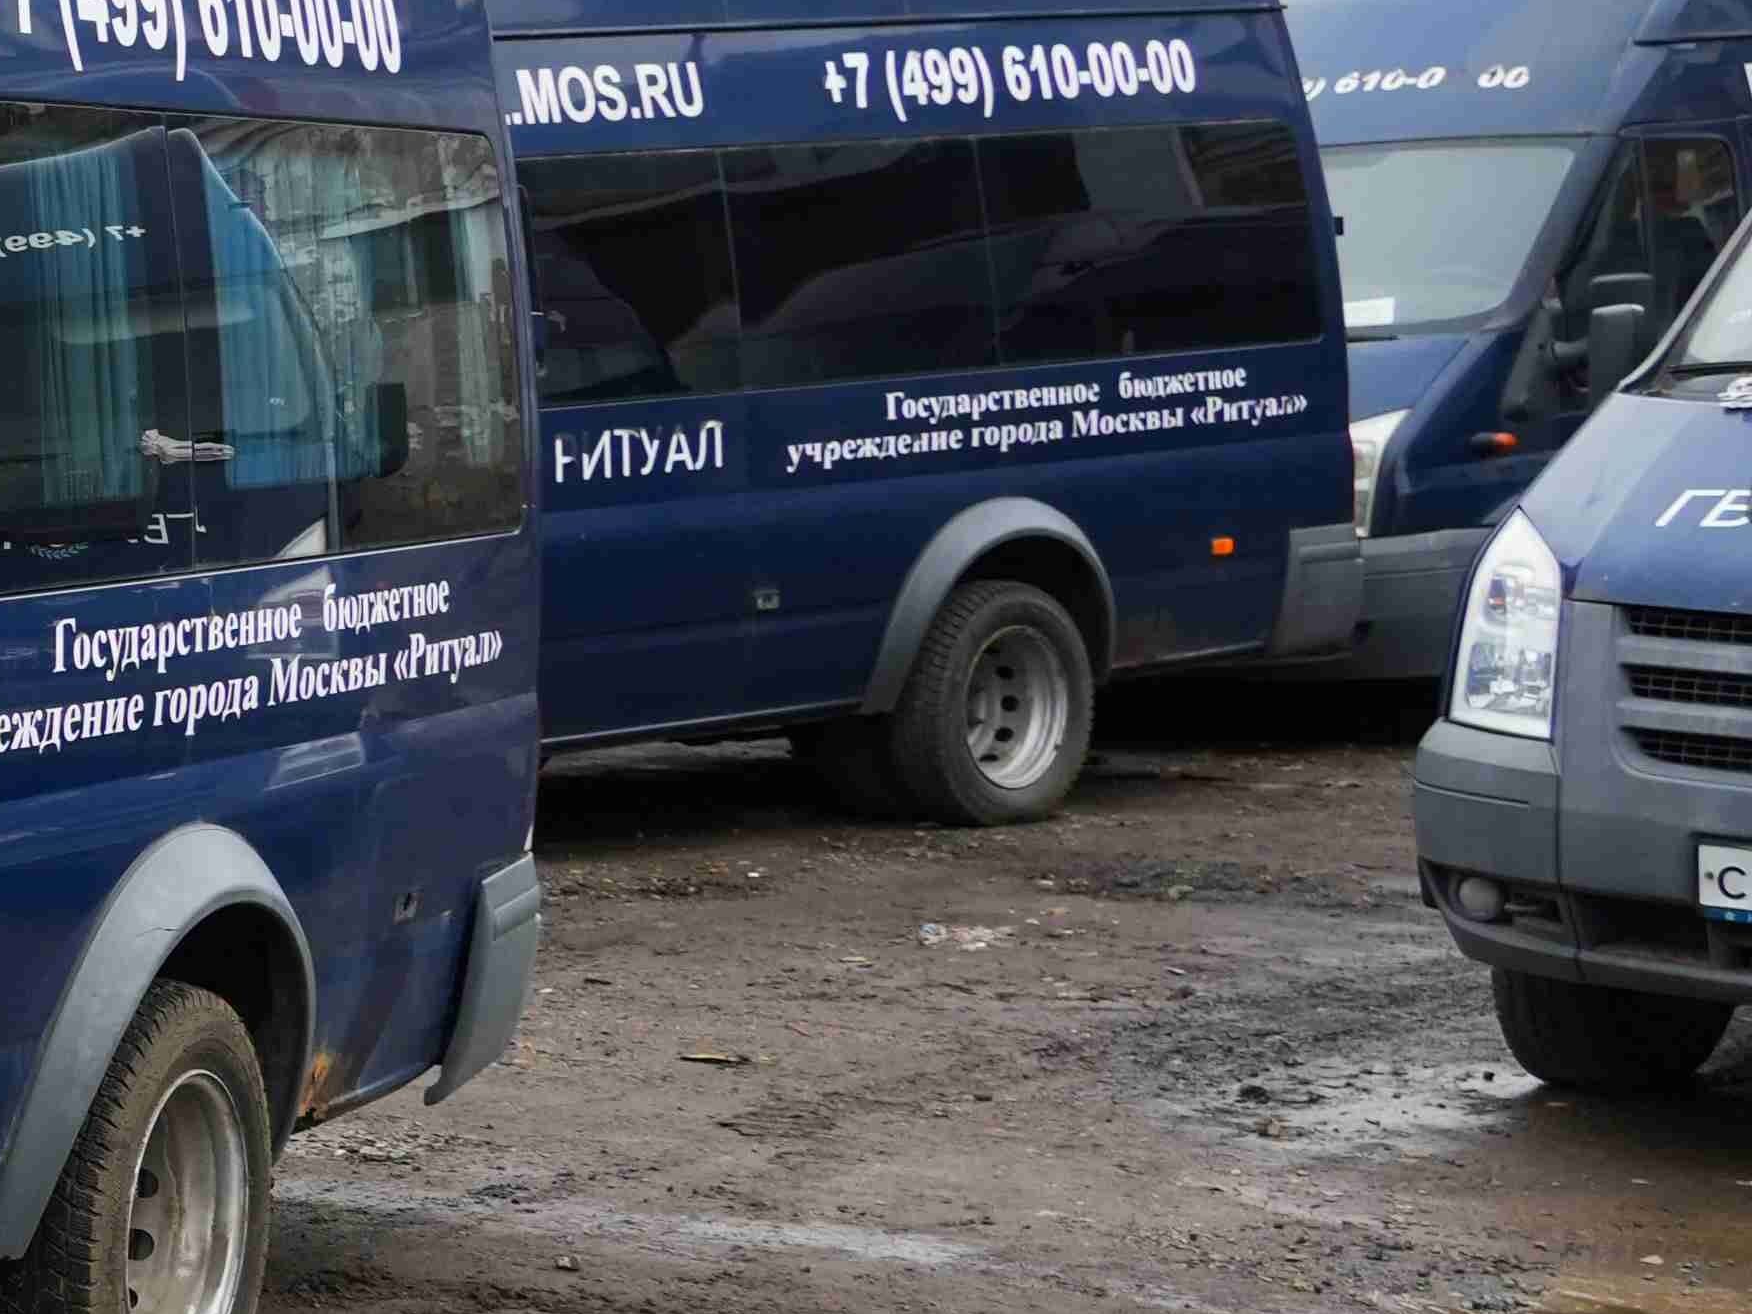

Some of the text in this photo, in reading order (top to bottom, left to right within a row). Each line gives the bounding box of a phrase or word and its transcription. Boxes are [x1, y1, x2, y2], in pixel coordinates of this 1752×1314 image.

[505, 61, 704, 126] .MOS.RU
[824, 38, 1197, 123] +7 (499) 610-00-00
[1118, 367, 1247, 401] бюджетное
[971, 418, 1063, 453] города
[1071, 407, 1184, 438] Москвы
[52, 580, 450, 681] Государственное бюджетное
[153, 674, 260, 736] города
[267, 652, 387, 707] Москвы
[394, 630, 503, 684] «Ритуал»
